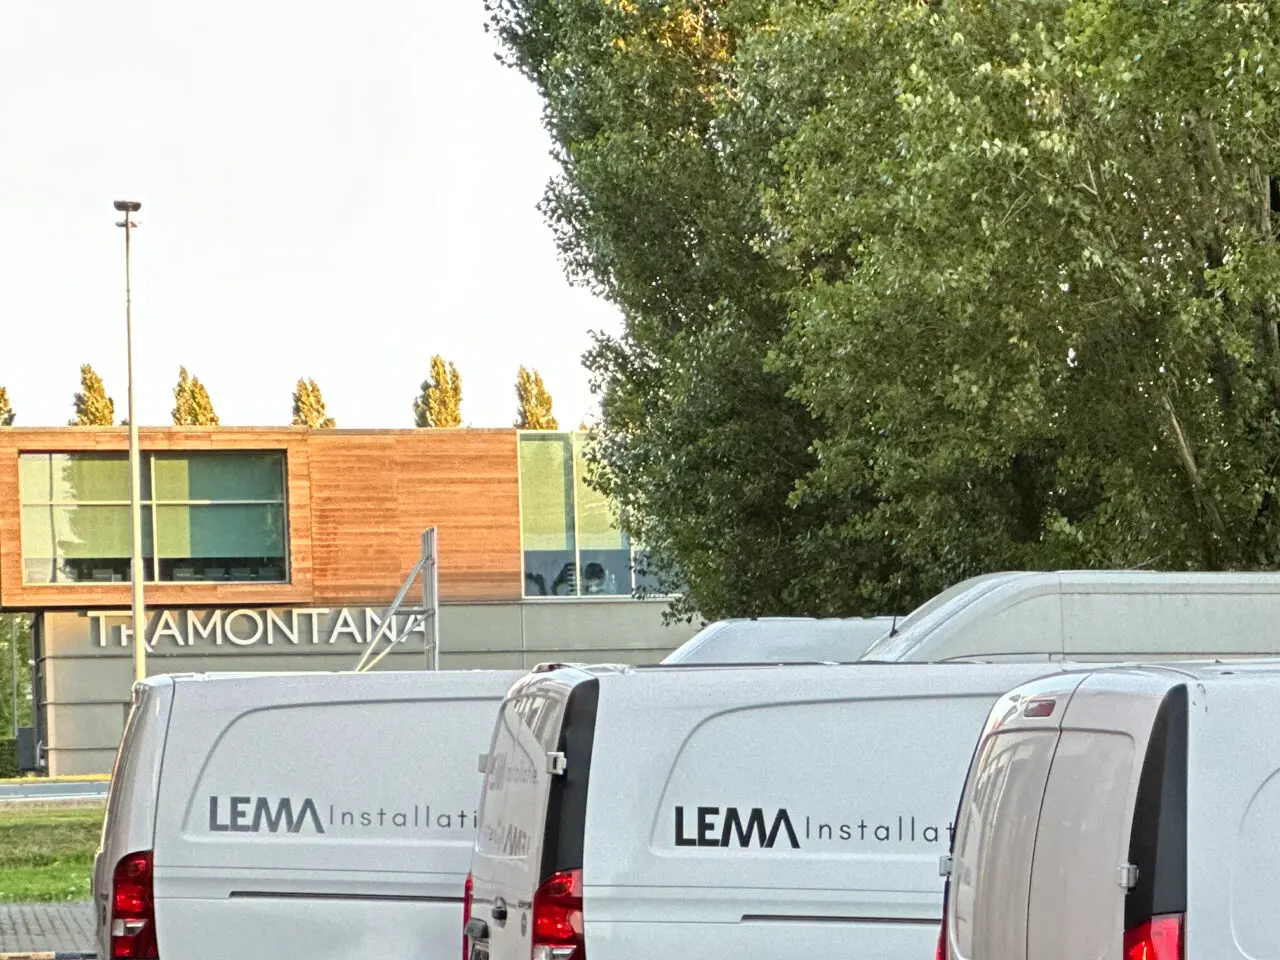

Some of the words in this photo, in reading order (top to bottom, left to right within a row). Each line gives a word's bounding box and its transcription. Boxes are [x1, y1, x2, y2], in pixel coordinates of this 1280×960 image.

[87, 607, 425, 652] TRAMONTANA
[209, 796, 325, 834] LEMA
[675, 806, 801, 849] LEMA
